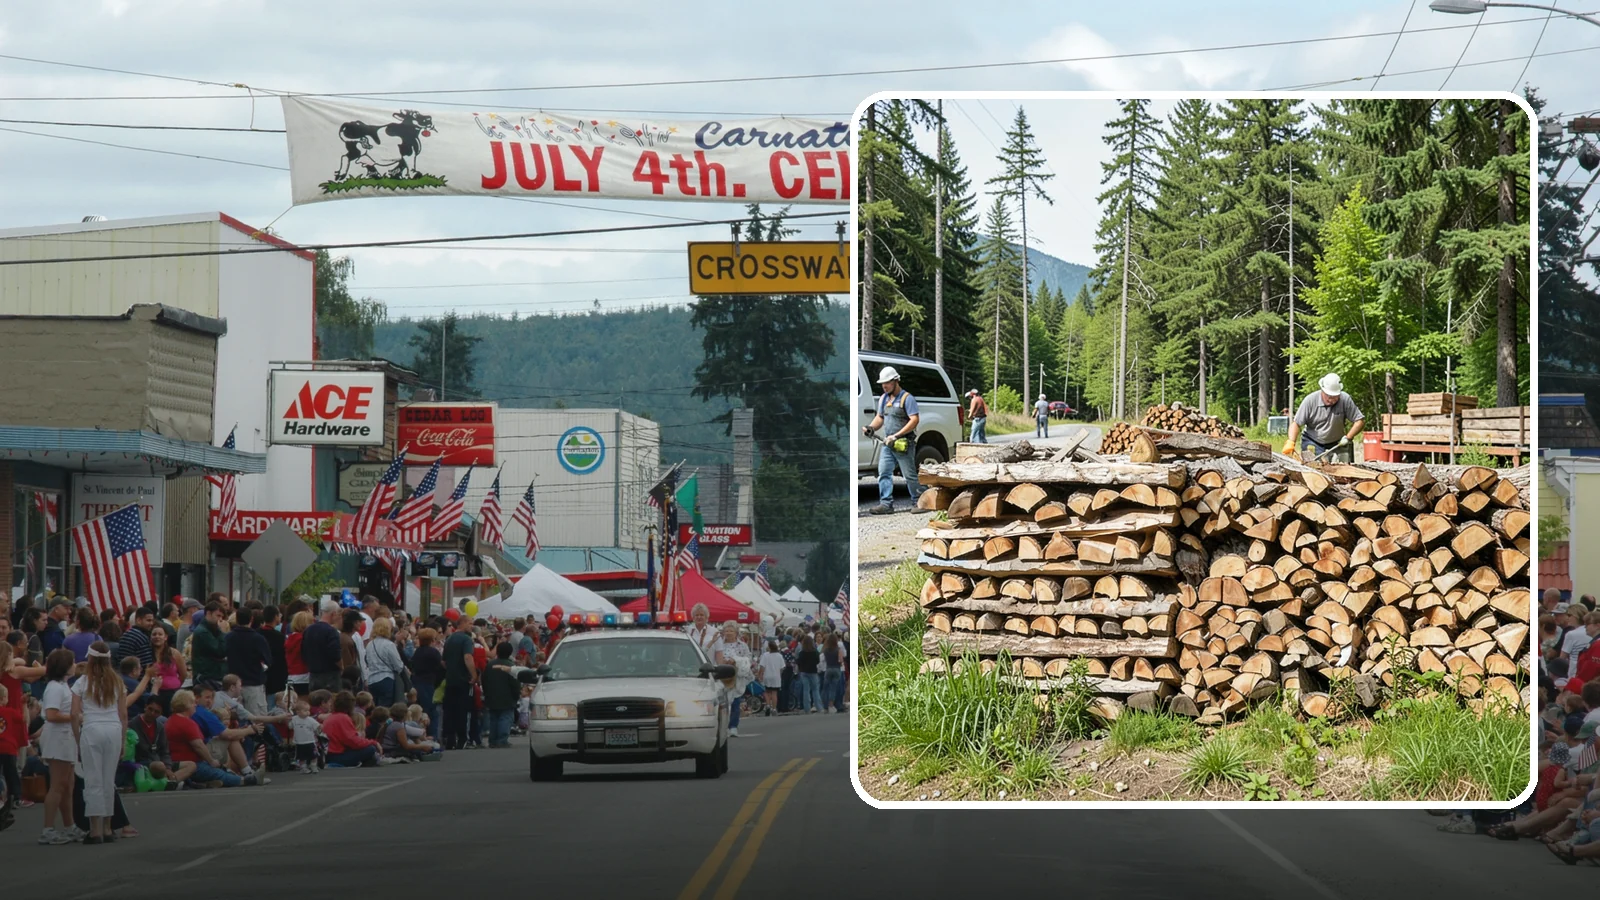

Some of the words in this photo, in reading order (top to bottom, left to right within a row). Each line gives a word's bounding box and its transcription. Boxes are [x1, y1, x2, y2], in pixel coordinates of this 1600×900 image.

[481, 141, 605, 193] JULY
[632, 150, 746, 197] 4th.
[697, 254, 850, 280] CROSSWA
[282, 380, 373, 420] ACE
[406, 409, 452, 422] CEDAR
[283, 421, 371, 436] Hardware
[416, 428, 476, 447] Coca-Cola
[353, 467, 386, 481] Simpl
[83, 485, 94, 494] St.
[95, 485, 124, 495] Vincent
[126, 486, 136, 495] de
[137, 486, 155, 495] Paul
[81, 503, 154, 522] THT
[688, 526, 741, 535] CRNATION
[699, 535, 730, 543] GLASS
